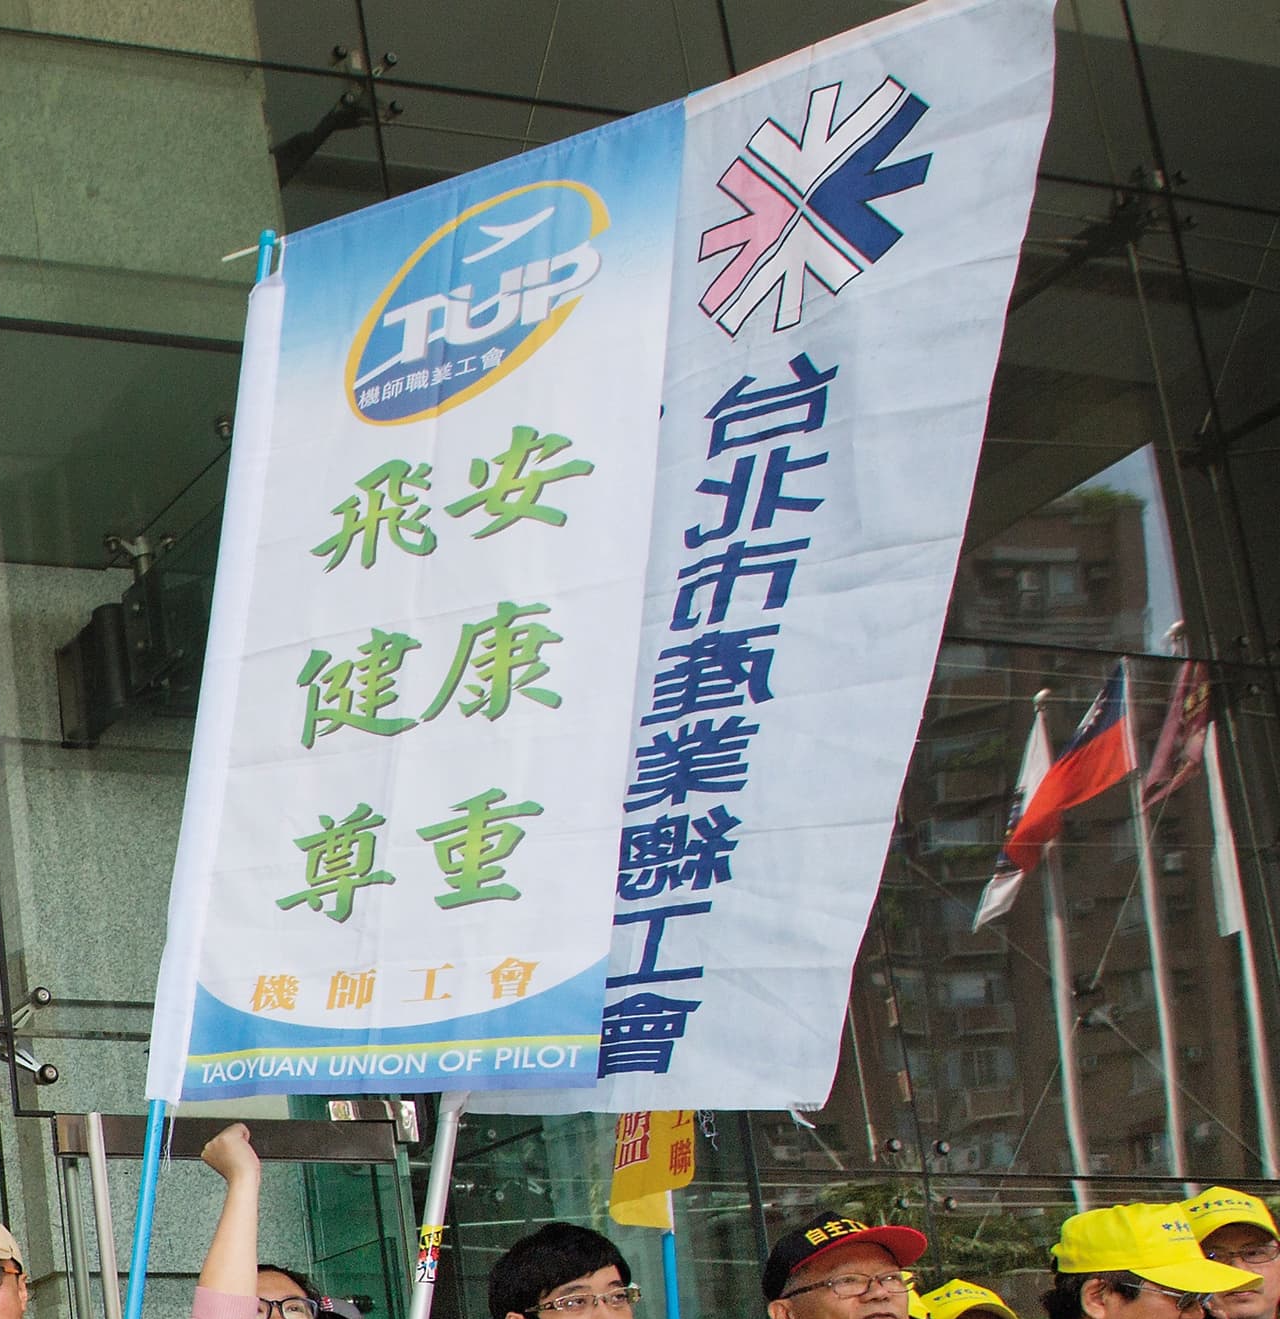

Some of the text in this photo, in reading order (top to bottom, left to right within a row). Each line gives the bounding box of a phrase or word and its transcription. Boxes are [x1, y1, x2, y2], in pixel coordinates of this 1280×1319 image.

[365, 240, 602, 375] TUP
[358, 347, 505, 409] 機師職業工會
[311, 425, 594, 572] 飛安
[296, 602, 564, 749] 健康
[276, 788, 545, 923] 尊重
[250, 957, 540, 1012] 機師工會
[201, 1045, 582, 1084] TAOYUAN UNION OF PILOT
[804, 1218, 871, 1246] 自主工
